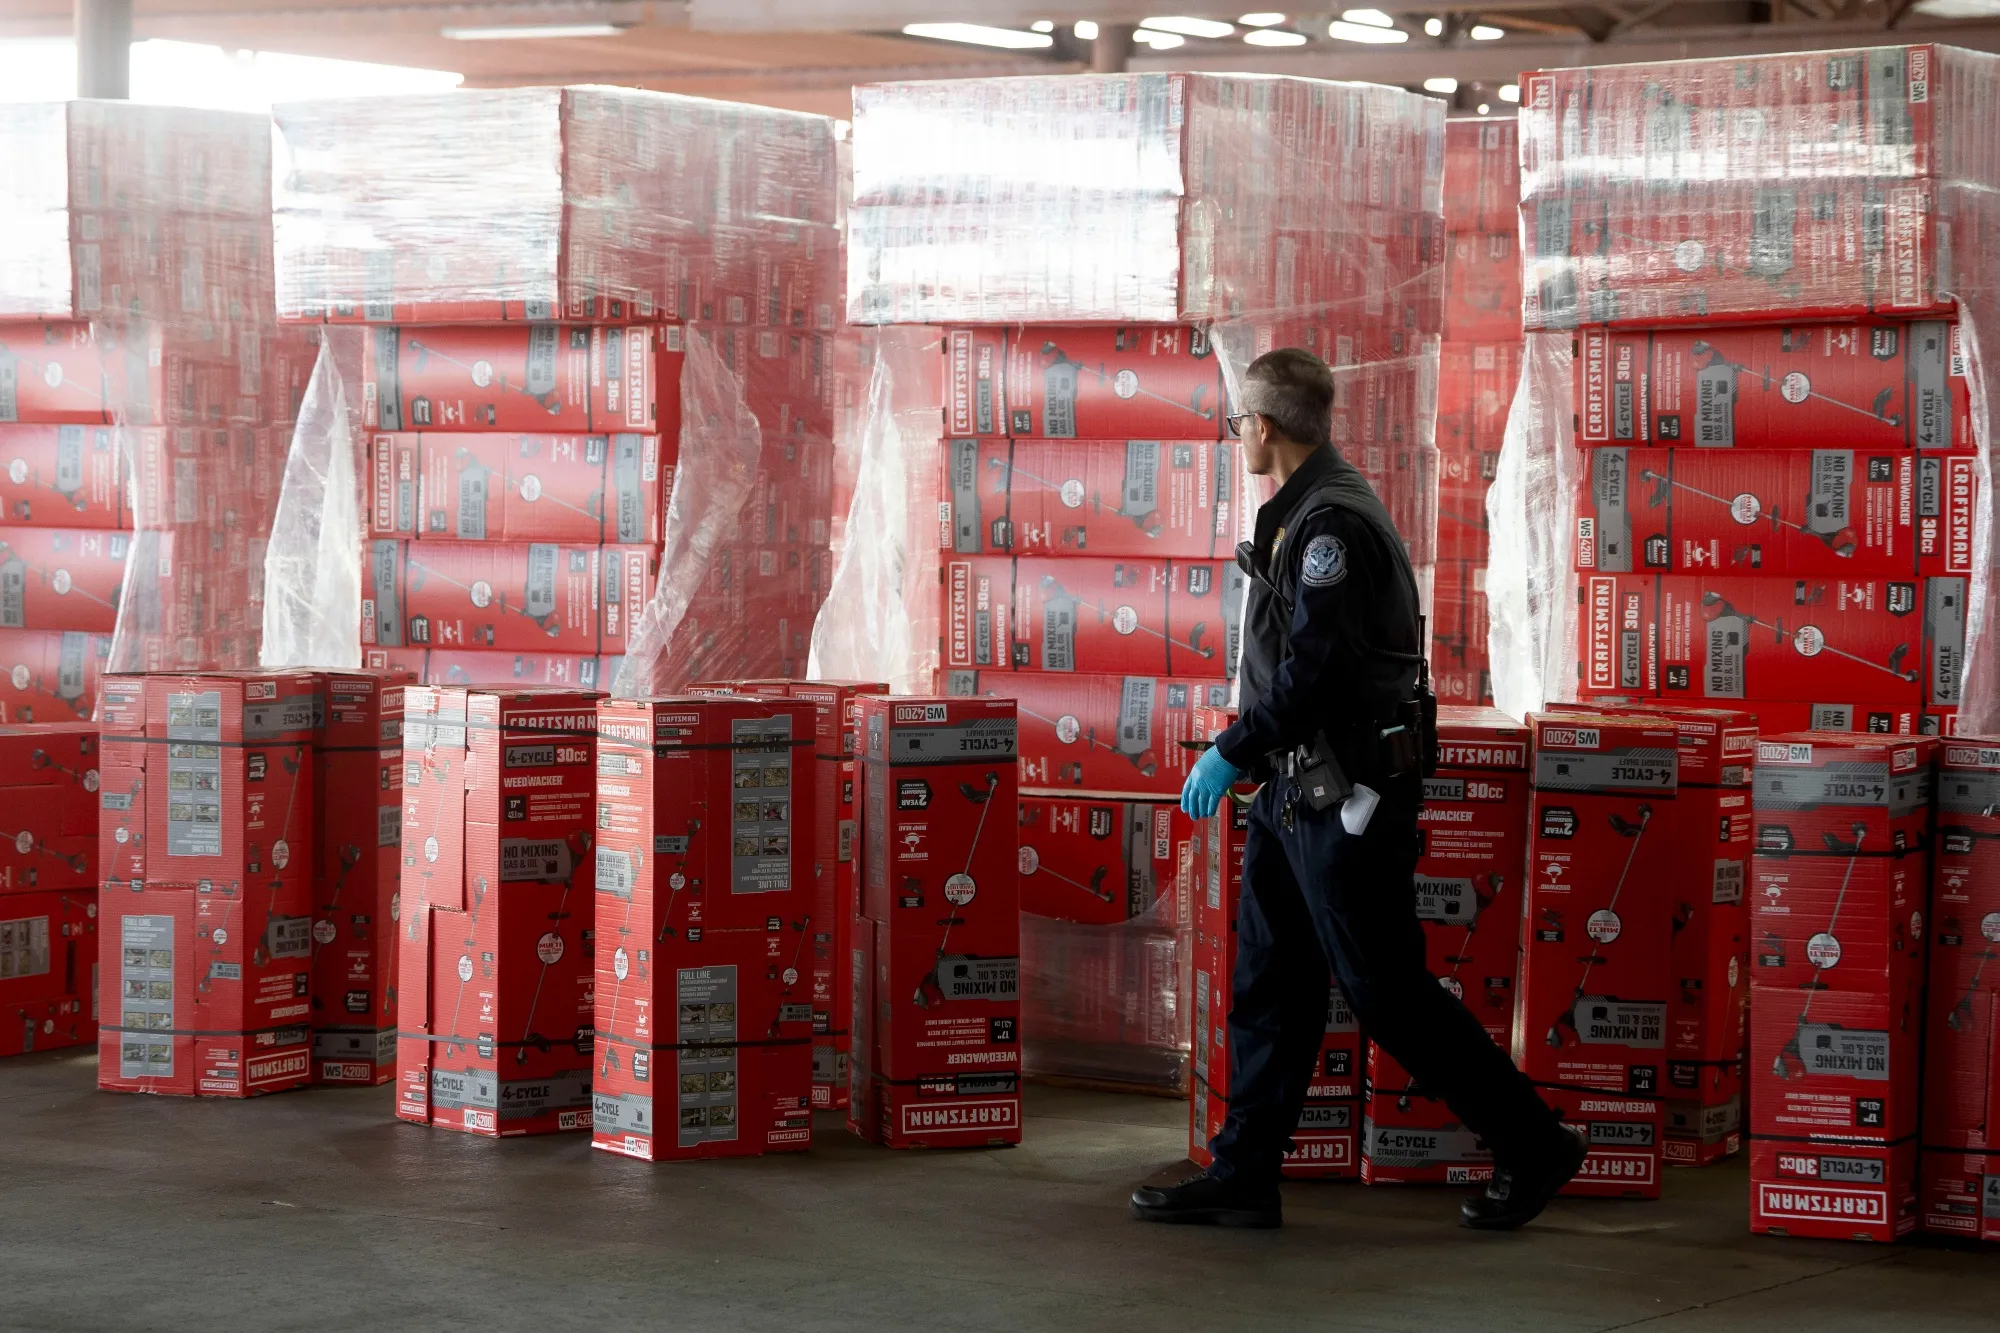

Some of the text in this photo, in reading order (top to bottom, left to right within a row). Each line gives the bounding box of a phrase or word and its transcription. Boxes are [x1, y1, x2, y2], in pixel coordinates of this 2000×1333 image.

[1954, 357, 1964, 374] WS
[631, 333, 641, 420] CRAFTSMAN
[956, 338, 967, 428] CRAFTSMAN
[1589, 337, 1602, 433] CRAFTSMAN
[1619, 386, 1630, 437] 4-CYCLE
[1702, 380, 1713, 440] NO MIXING
[1715, 402, 1723, 413] OIL
[1921, 388, 1934, 442] 4-CYCLE
[1715, 425, 1723, 440] GAS
[963, 444, 975, 492] 4-CYCLE
[1824, 456, 1832, 473] GAS
[1880, 464, 1889, 475] 17"
[379, 439, 389, 527] CRAFTSMAN
[1609, 454, 1624, 507] 4-CYCLE
[1823, 475, 1832, 483] &
[1832, 456, 1845, 518] NO MIXING
[1900, 456, 1911, 526] WEEDWACKER
[1923, 460, 1937, 514] 4-CYCLE
[1953, 464, 1968, 564] CRAFTSMAN
[1580, 520, 1592, 565] WS 4200
[954, 568, 965, 659] CRAFTSMAN
[1890, 603, 1900, 612] 2
[977, 615, 988, 663] 4-CYCLE
[1595, 585, 1610, 681] CRAFTSMAN
[1049, 652, 1056, 667] NO
[1624, 634, 1638, 685] 4-CYCLE
[1712, 630, 1723, 691] NO MIXING
[1725, 655, 1733, 665] OIL
[1938, 646, 1951, 699] 4-CYCLE
[1725, 677, 1733, 691] GAS
[899, 706, 945, 720] WS 4200
[1138, 683, 1149, 740] NO MIXING
[1823, 711, 1832, 726] GAS
[1834, 711, 1844, 726] NO
[510, 715, 596, 729] CRAFTSMAN
[602, 724, 647, 740] CRAFTSMAN
[1546, 730, 1597, 744] WS 4200
[960, 738, 1014, 752] 4-CYCLE
[508, 750, 553, 764] 4-CYCLE
[1762, 746, 1809, 760] WS 4200
[1950, 749, 1978, 763] 4200
[1619, 758, 1639, 766] SHAFT
[1612, 767, 1671, 784] 4-CYCLE
[1423, 785, 1462, 797] CYCLE
[1824, 784, 1884, 800] 4-CYCLE
[920, 795, 927, 806] 2
[1418, 811, 1473, 821] EDWACKER
[1158, 813, 1168, 856] WS 4200
[1545, 823, 1572, 834] 2 YEAR
[504, 844, 558, 858] NO MIXING
[504, 858, 538, 869] GAS & OIL
[774, 880, 787, 888] FULL
[1180, 847, 1188, 917] CRAFTSMAN
[1416, 882, 1461, 896] MIXING
[1423, 897, 1436, 907] OIL
[680, 971, 710, 979] FULL LINE
[977, 970, 1015, 980] GAS & OIL
[953, 981, 1016, 995] NO MIXING
[1618, 1014, 1659, 1024] GAS & OIL
[998, 1031, 1009, 1039] 17"
[1590, 1025, 1659, 1040] NO MIXING
[1841, 1044, 1884, 1054] GAS & OIL
[948, 1052, 1017, 1064] WEEDWACKER
[1816, 1055, 1884, 1070] NO MIXING
[250, 1056, 305, 1078] CRAFTSMAN
[324, 1064, 368, 1078] WS 4200
[1333, 1064, 1344, 1072] 17"
[433, 1073, 464, 1091] 4-CYCLE
[1636, 1080, 1649, 1088] 17"
[502, 1085, 550, 1100] 4-CYCLE
[595, 1099, 619, 1117] 4-CYCLE
[1581, 1100, 1656, 1113] WEEDWACKER
[465, 1112, 492, 1128] WS 4200
[561, 1112, 594, 1126] WS 420
[911, 1108, 1010, 1126] CRAFTSMAN
[1864, 1113, 1877, 1123] 17"
[770, 1131, 807, 1141] CRAFTSMAN
[1377, 1131, 1436, 1148] 4-CYCLE
[1592, 1126, 1651, 1142] 4-CYCLE
[1284, 1144, 1343, 1159] CRAFT
[1377, 1148, 1429, 1158] STRAIGHT SHAFT
[1667, 1144, 1692, 1157] 4200
[1579, 1160, 1645, 1176] CRAFTS
[1822, 1160, 1880, 1178] 4-CYCLE
[1769, 1193, 1878, 1214] CRAFTSMAN
